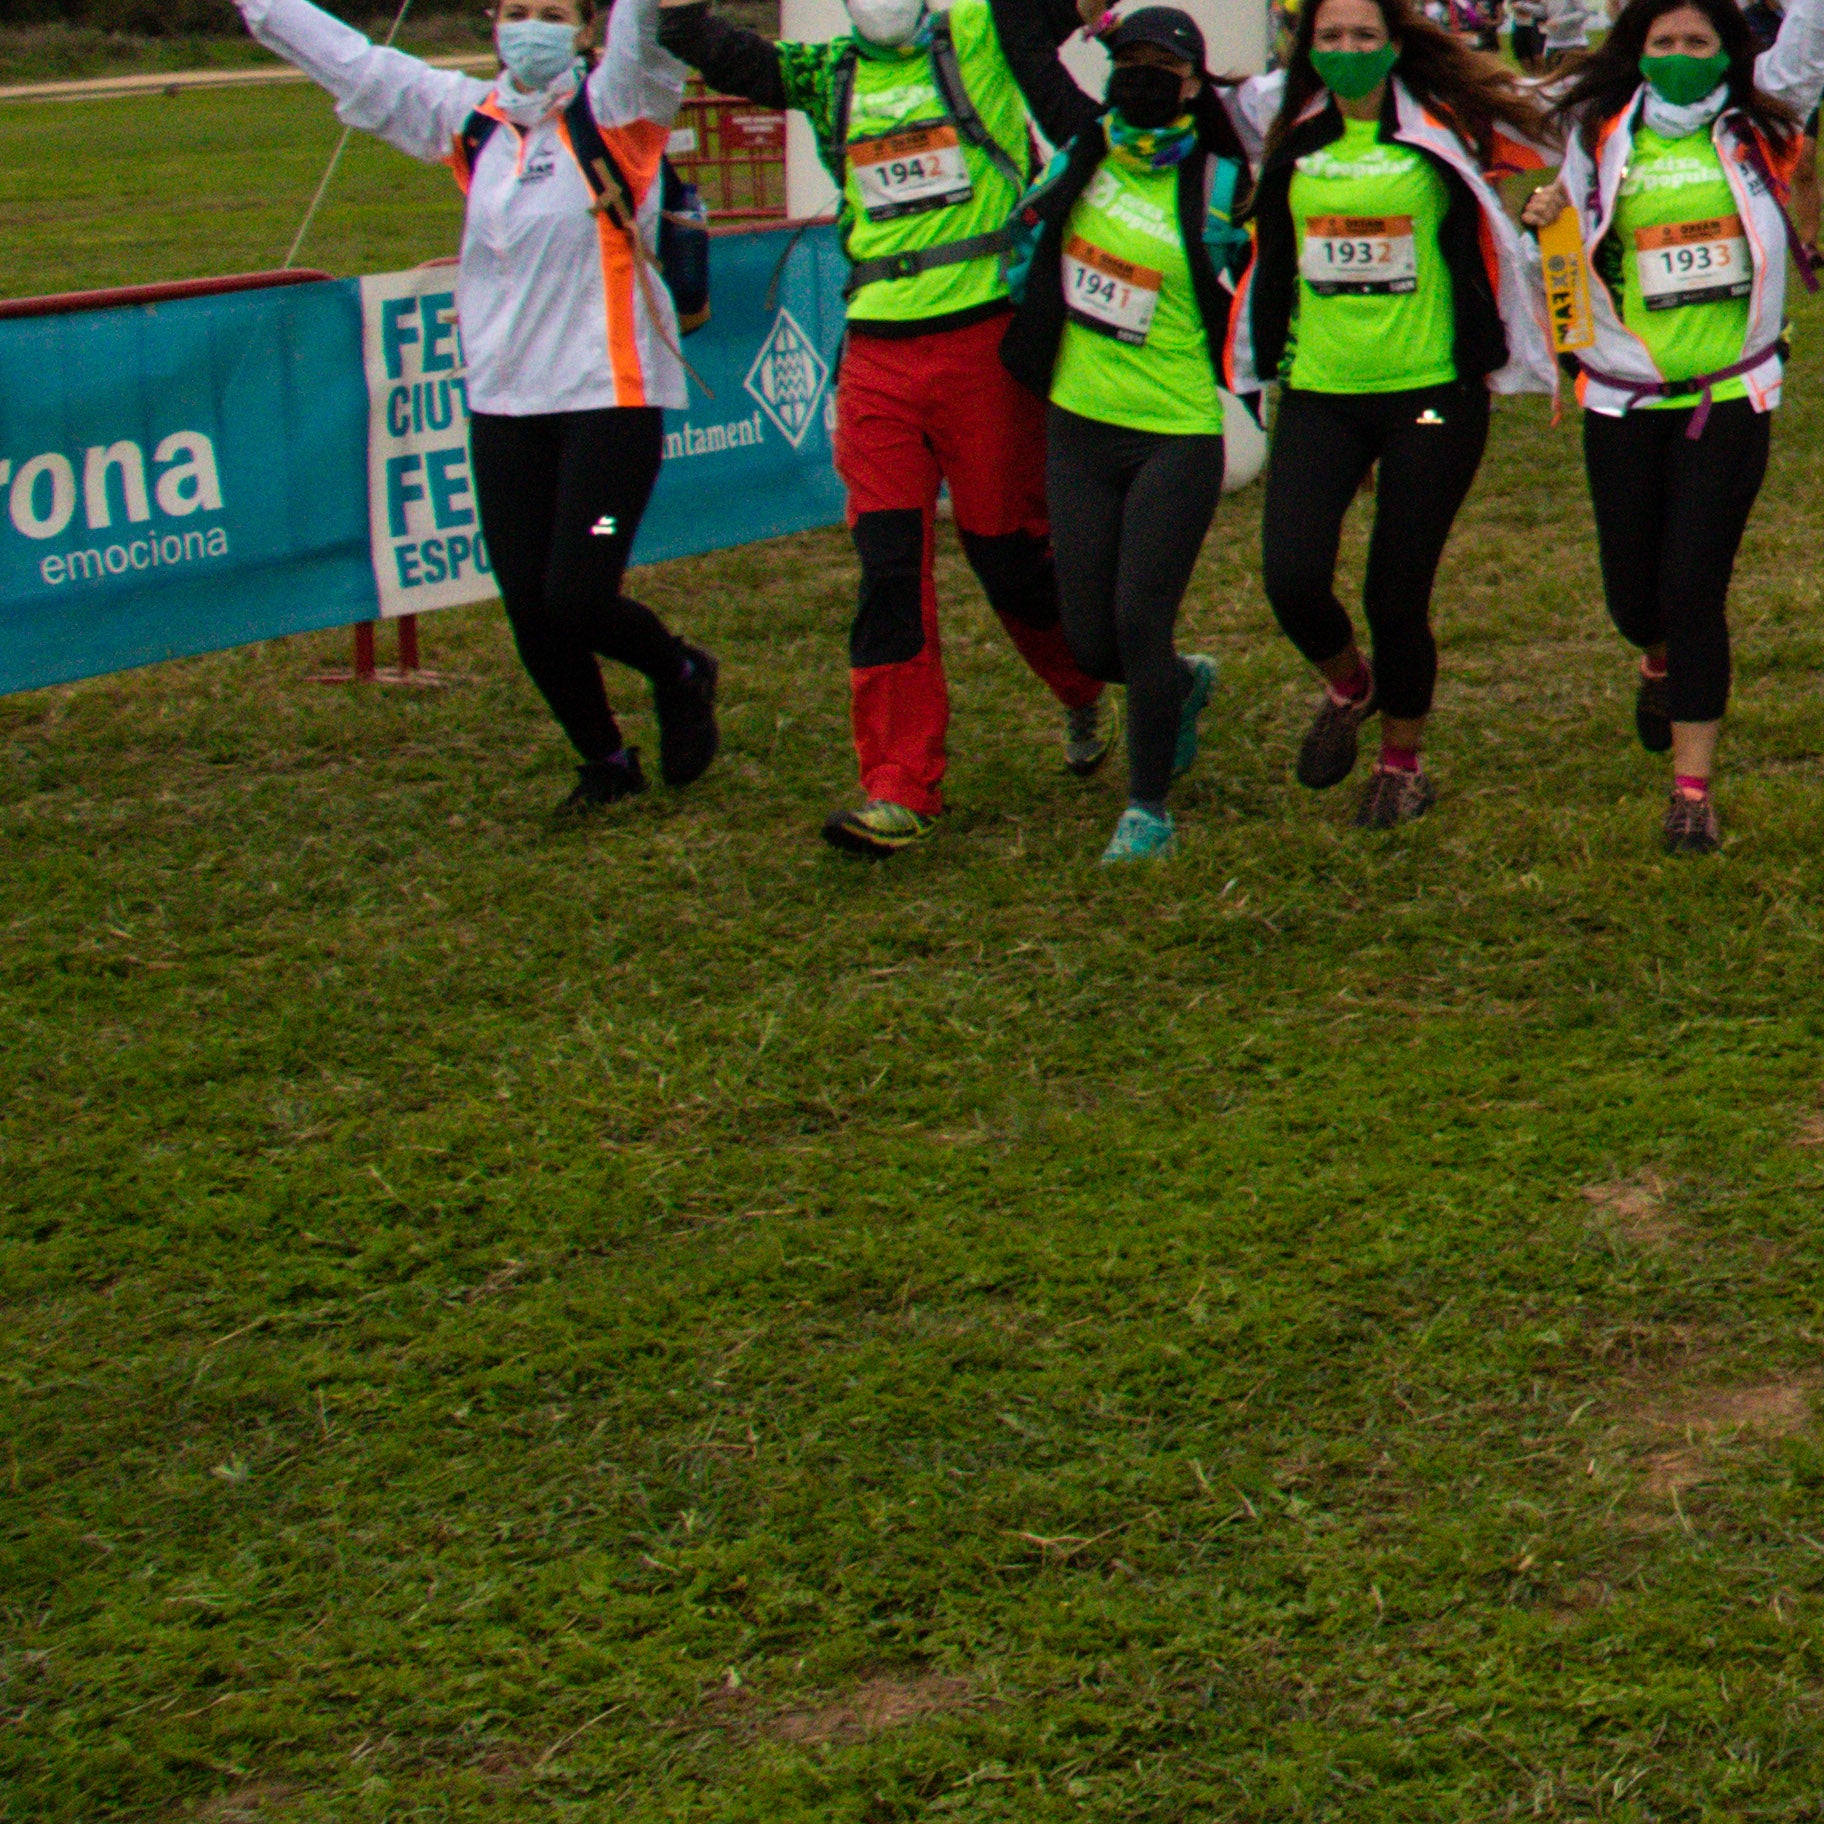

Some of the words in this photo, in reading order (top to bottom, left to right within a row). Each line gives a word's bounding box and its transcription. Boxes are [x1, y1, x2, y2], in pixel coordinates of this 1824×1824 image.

[875, 155, 943, 187] 1942
[1322, 240, 1392, 266] 1932
[1659, 244, 1732, 276] 1933
[1074, 266, 1132, 309] 1941
[382, 290, 467, 380] FE
[385, 376, 471, 439] CIUT
[662, 409, 764, 461] ntament
[386, 446, 475, 538] FE
[40, 526, 229, 586] emociona
[394, 530, 493, 589] ESPO
